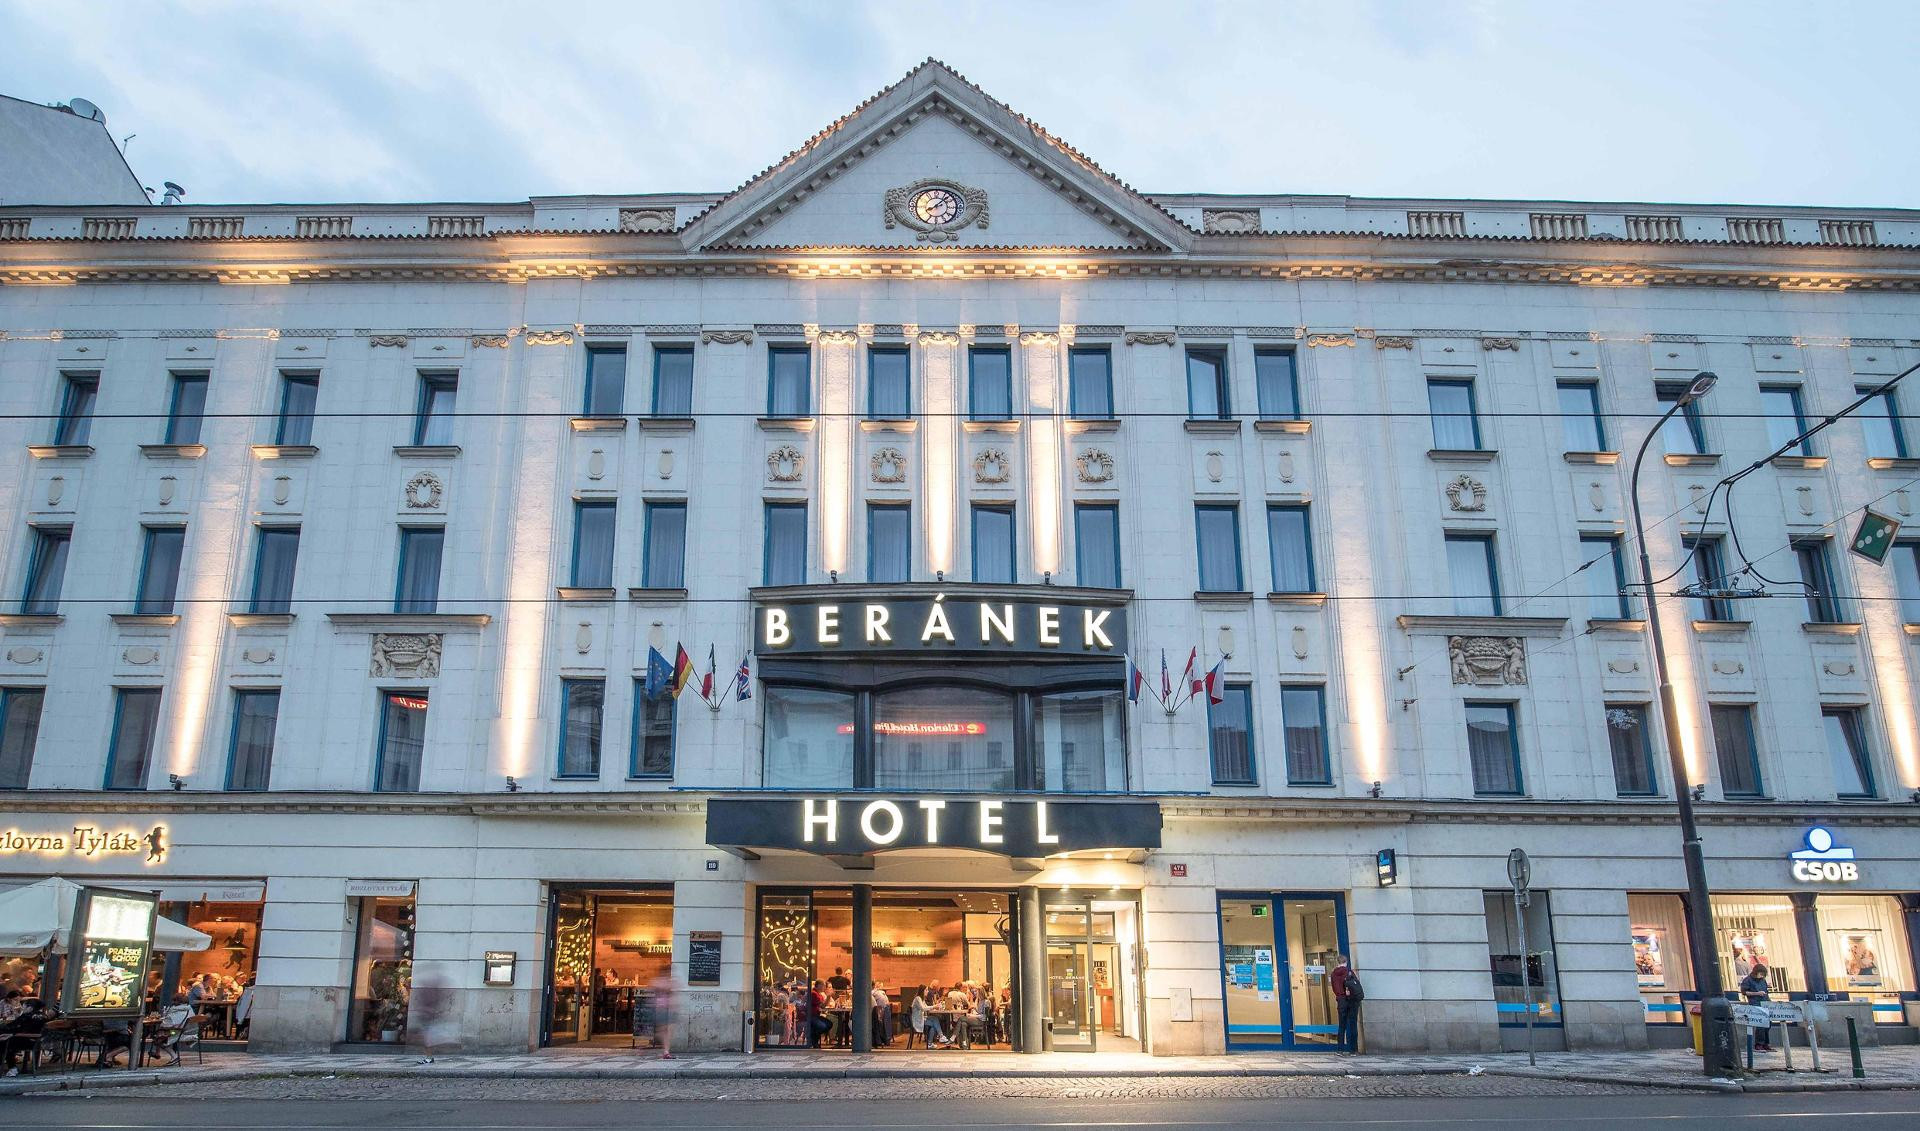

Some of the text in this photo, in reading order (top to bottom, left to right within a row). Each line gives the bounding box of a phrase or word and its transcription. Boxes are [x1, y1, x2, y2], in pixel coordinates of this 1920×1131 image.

[765, 593, 1114, 648] BERÁNEK
[803, 799, 1059, 845] HOTEL
[73, 826, 137, 856] Tylák
[1793, 860, 1859, 881] ČSOB
[108, 946, 142, 956] PRAŽSKÉ
[112, 954, 141, 962] SCHODY
[84, 985, 124, 1008] 25
